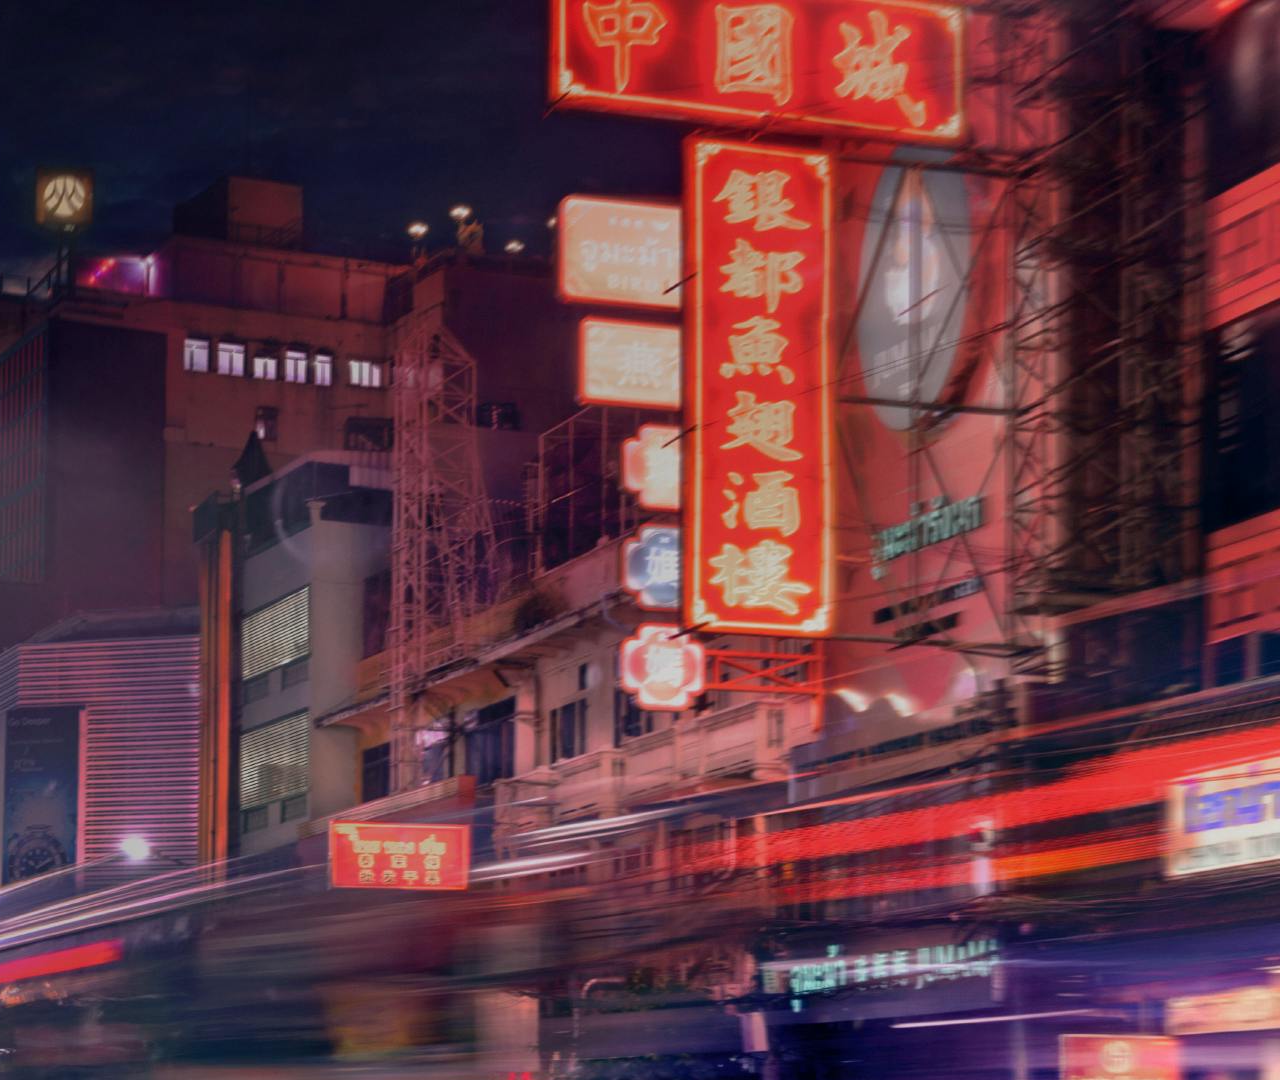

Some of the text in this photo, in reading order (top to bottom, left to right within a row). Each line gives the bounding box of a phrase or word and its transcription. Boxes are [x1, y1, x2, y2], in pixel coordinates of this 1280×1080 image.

[581, 0, 928, 128] 中國城
[709, 169, 813, 617] 銀都魚翅酒樓
